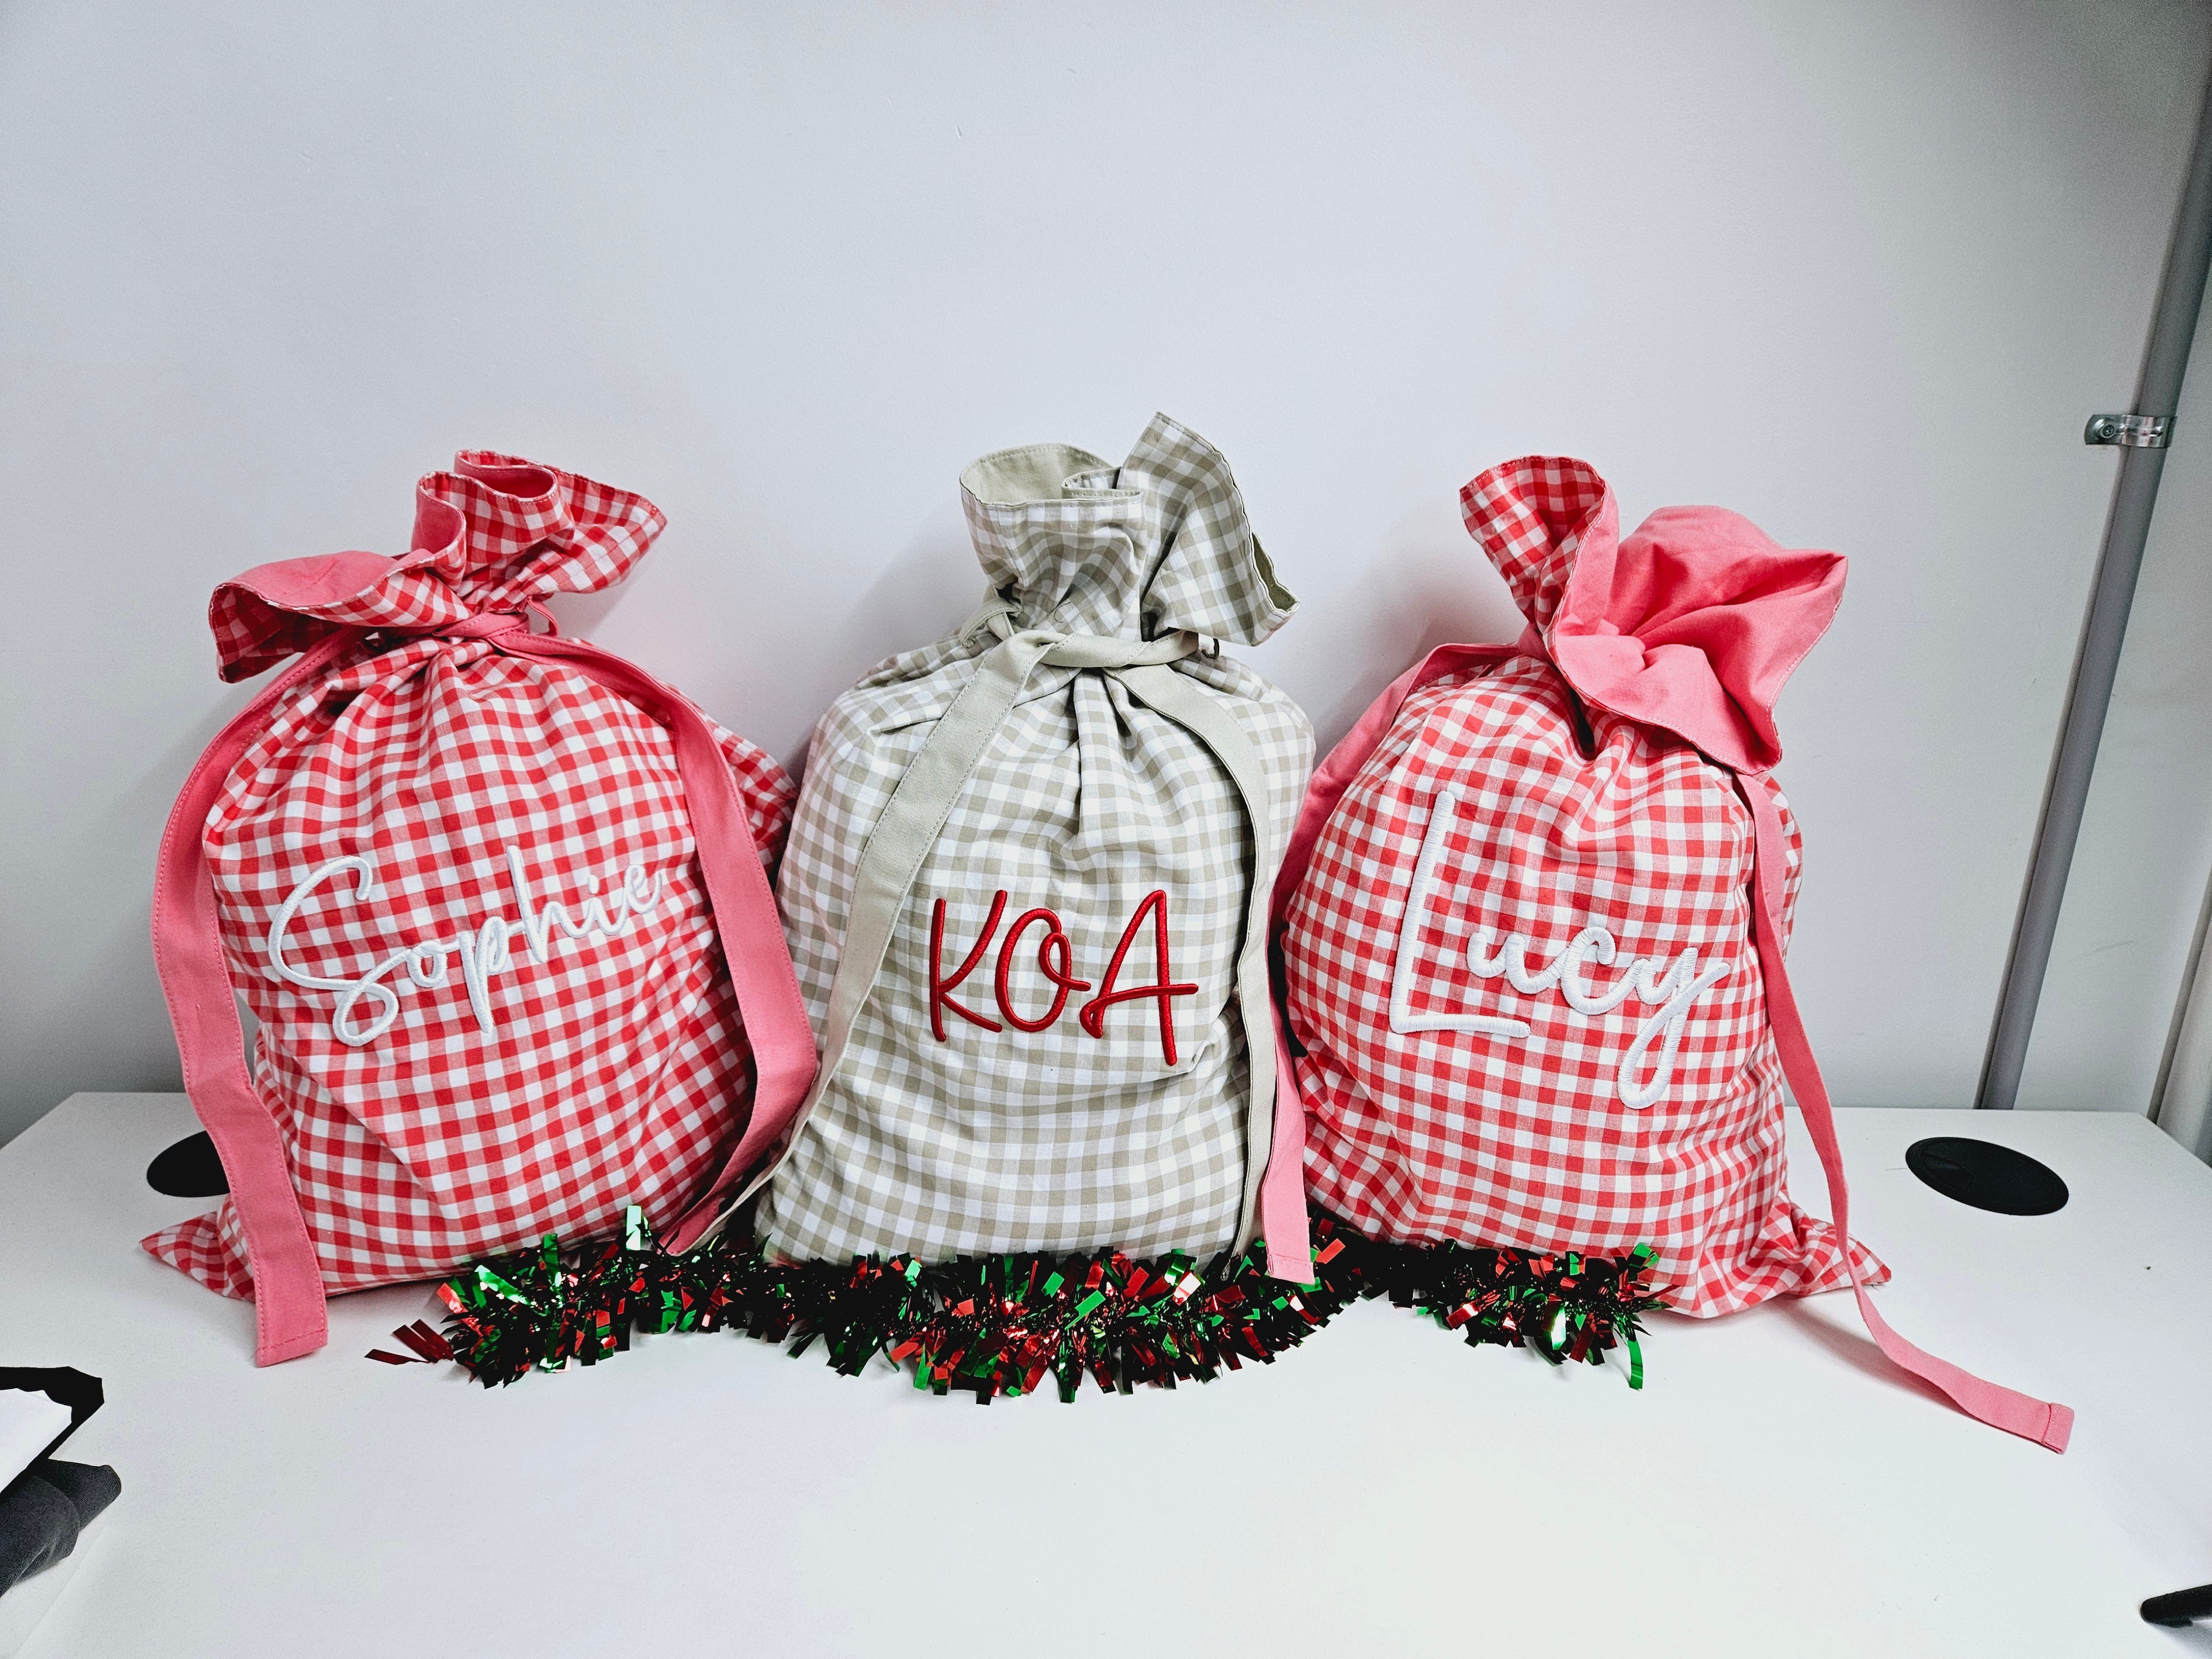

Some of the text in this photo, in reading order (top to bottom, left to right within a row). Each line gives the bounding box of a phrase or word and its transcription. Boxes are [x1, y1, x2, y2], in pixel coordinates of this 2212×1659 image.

[268, 844, 662, 1047] Sophie
[929, 889, 1199, 1066] KOA
[1389, 790, 1730, 1109] Lucy
